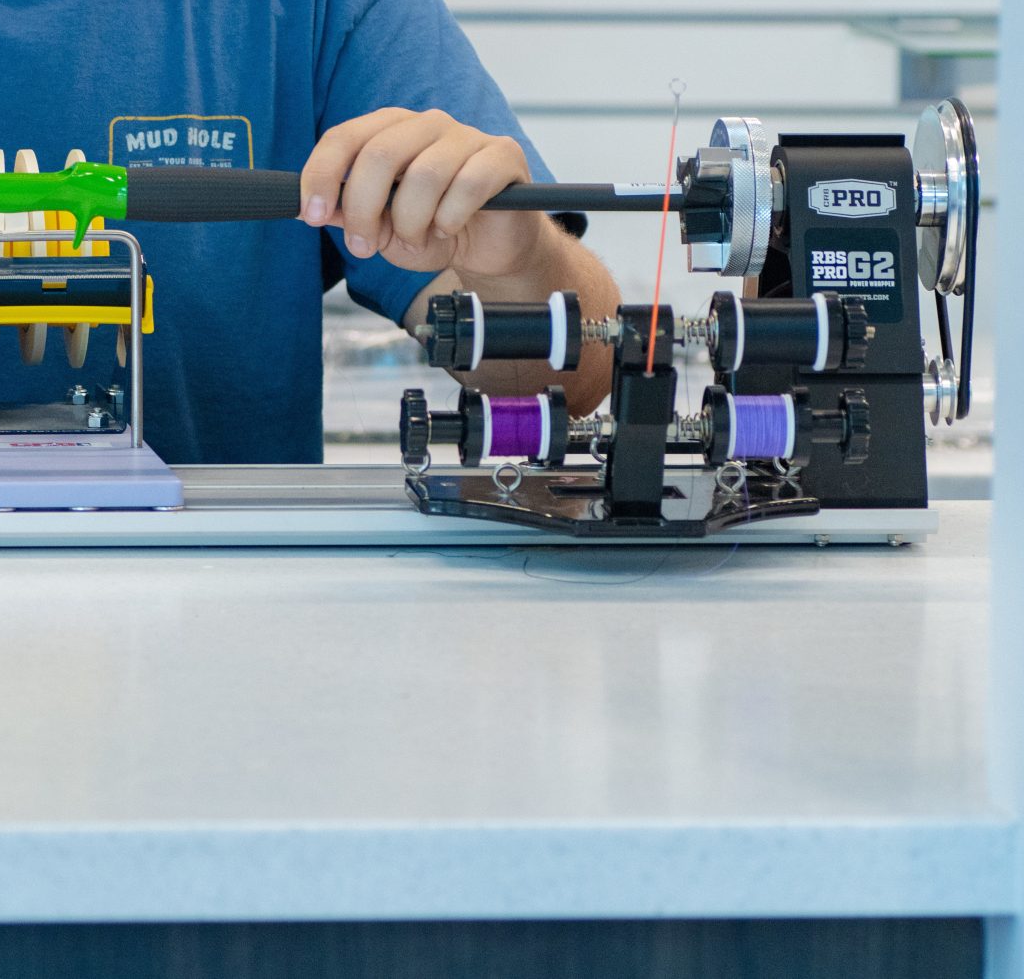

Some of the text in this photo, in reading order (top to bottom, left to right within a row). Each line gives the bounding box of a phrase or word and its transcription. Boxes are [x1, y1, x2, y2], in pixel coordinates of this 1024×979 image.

[126, 127, 236, 152] MUD HOLE
[832, 189, 882, 207] PRO
[811, 251, 847, 265] RBS
[848, 251, 895, 280] G2
[812, 266, 848, 279] PRO
